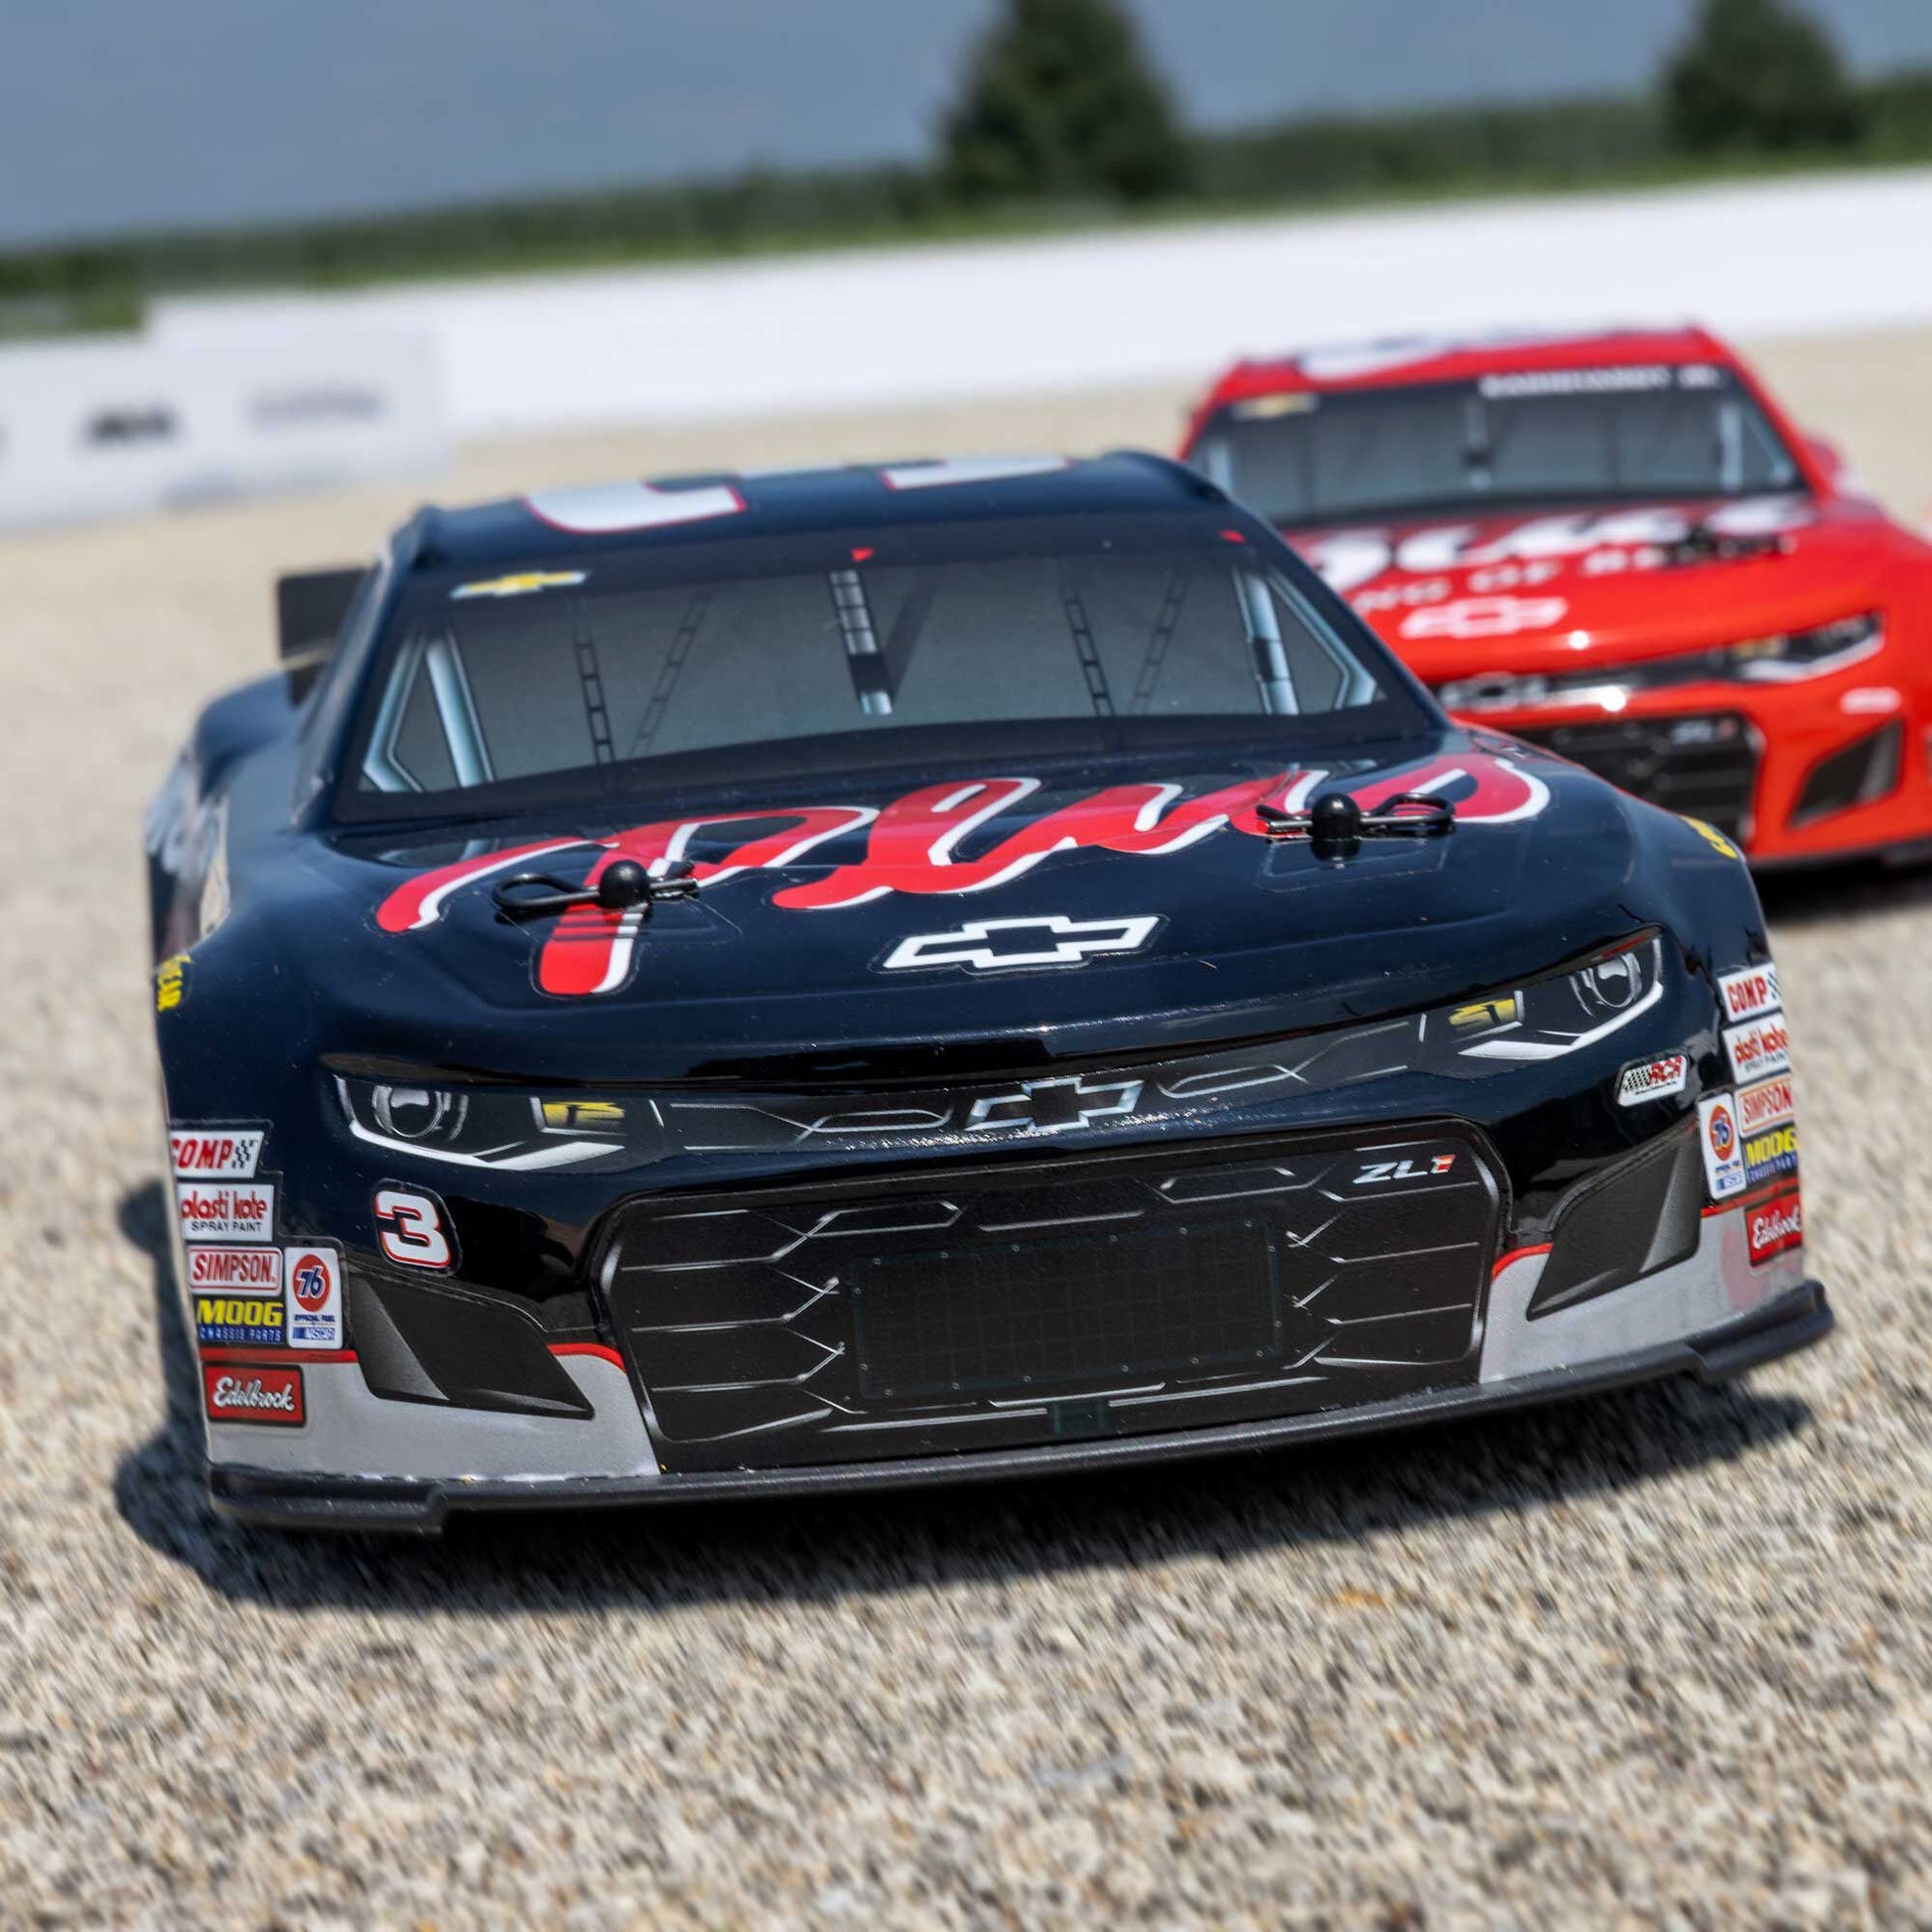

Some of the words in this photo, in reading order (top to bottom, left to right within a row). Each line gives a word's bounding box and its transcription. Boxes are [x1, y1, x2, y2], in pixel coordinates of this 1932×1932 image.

[1726, 975, 1768, 1014] COMP
[1712, 1113, 1732, 1151] 76
[1745, 1127, 1800, 1167] MOOG
[192, 1221, 229, 1233] SPRAY
[232, 1221, 262, 1233] PAINT
[373, 1189, 452, 1270] 3
[296, 1265, 327, 1299] 76
[198, 1299, 284, 1327] MOOG
[212, 1376, 295, 1412] Edelbrock
